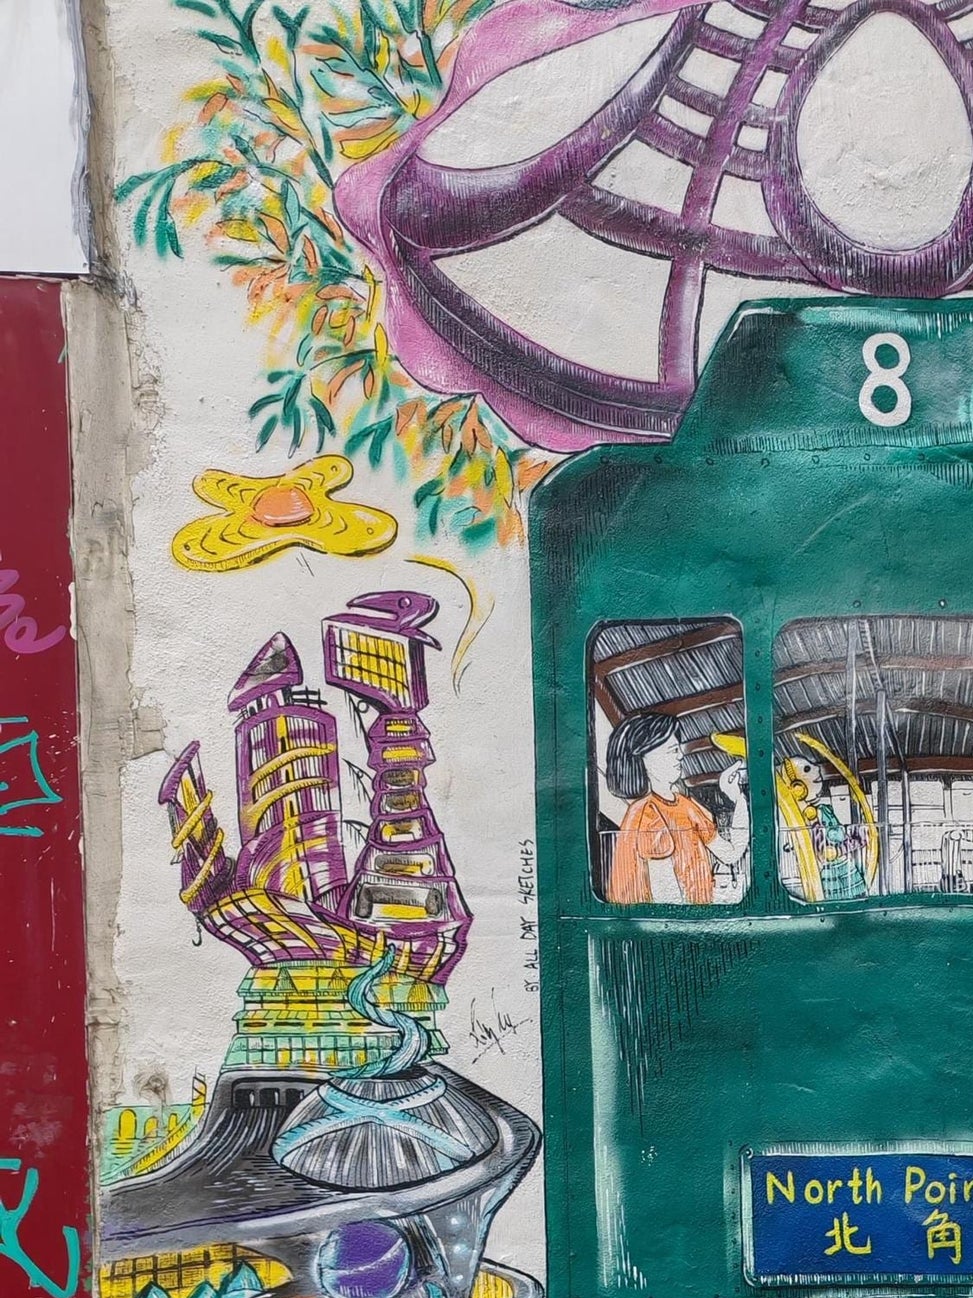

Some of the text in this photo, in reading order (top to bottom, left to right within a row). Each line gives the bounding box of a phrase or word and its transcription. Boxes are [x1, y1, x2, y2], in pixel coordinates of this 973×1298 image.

[859, 332, 912, 427] 8
[517, 838, 536, 905] SKETCHES
[520, 916, 537, 940] DAY
[525, 949, 538, 971] ALL
[765, 1166, 882, 1205] North
